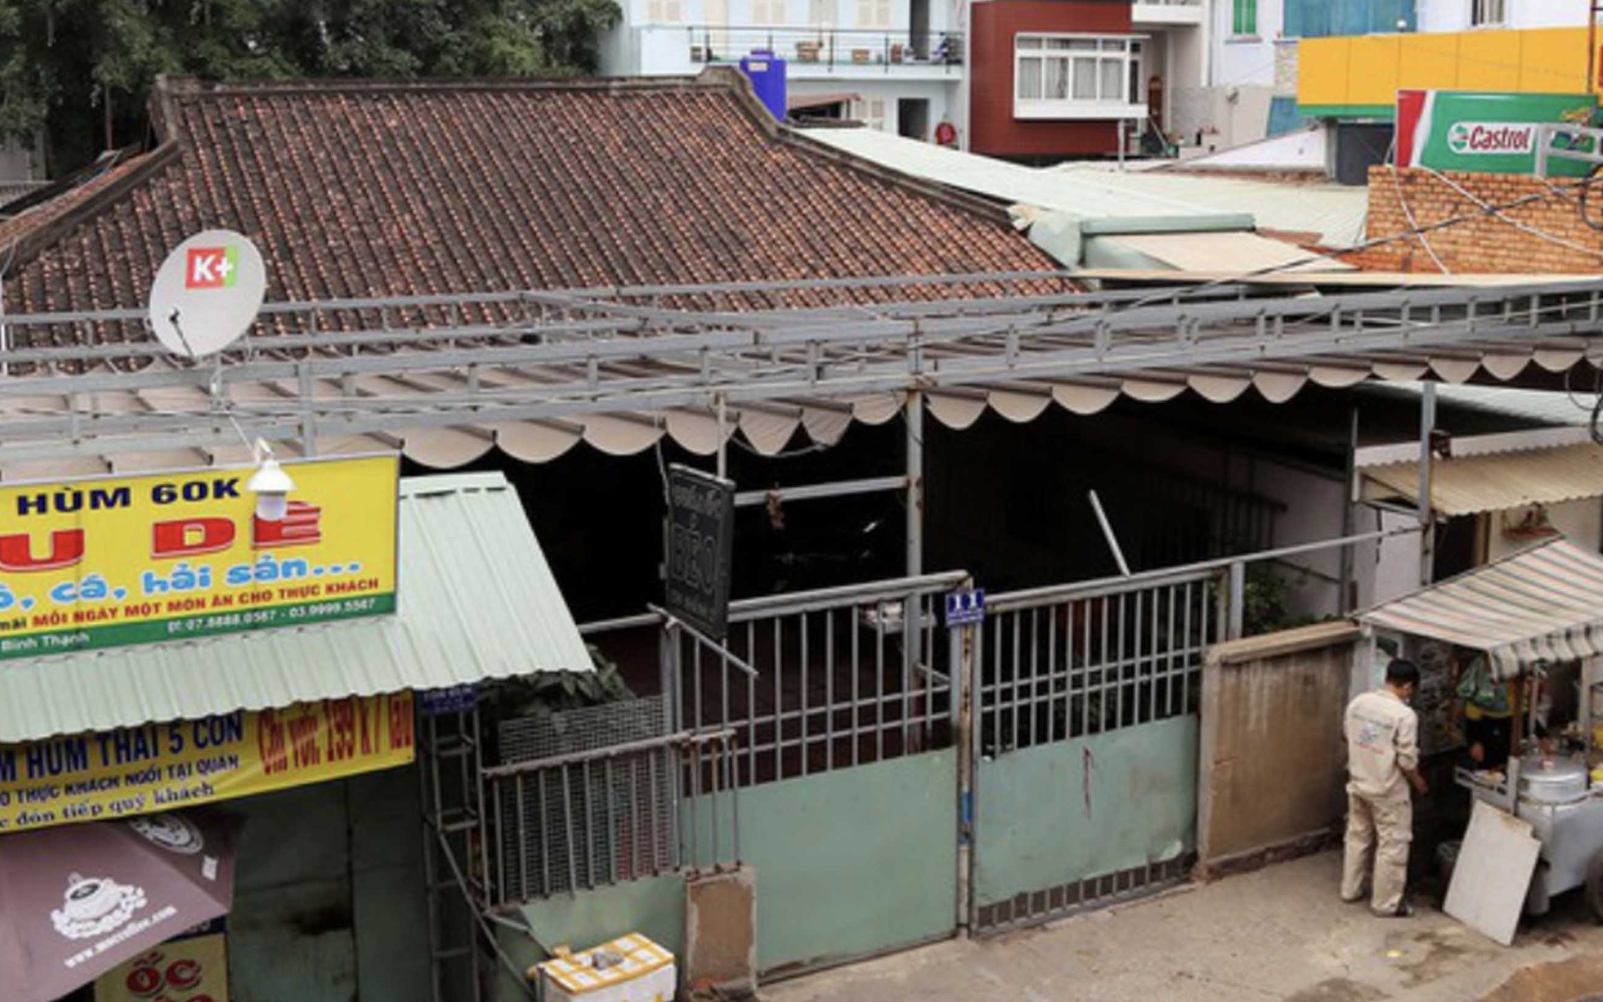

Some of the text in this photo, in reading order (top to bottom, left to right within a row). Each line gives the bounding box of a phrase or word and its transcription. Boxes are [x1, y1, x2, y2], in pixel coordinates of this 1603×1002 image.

[1469, 125, 1530, 150] Castrol
[193, 254, 233, 282] K+
[17, 478, 239, 516] HÙM 60K
[143, 563, 211, 596] hải
[239, 588, 273, 605] CHO
[168, 719, 185, 755] 5
